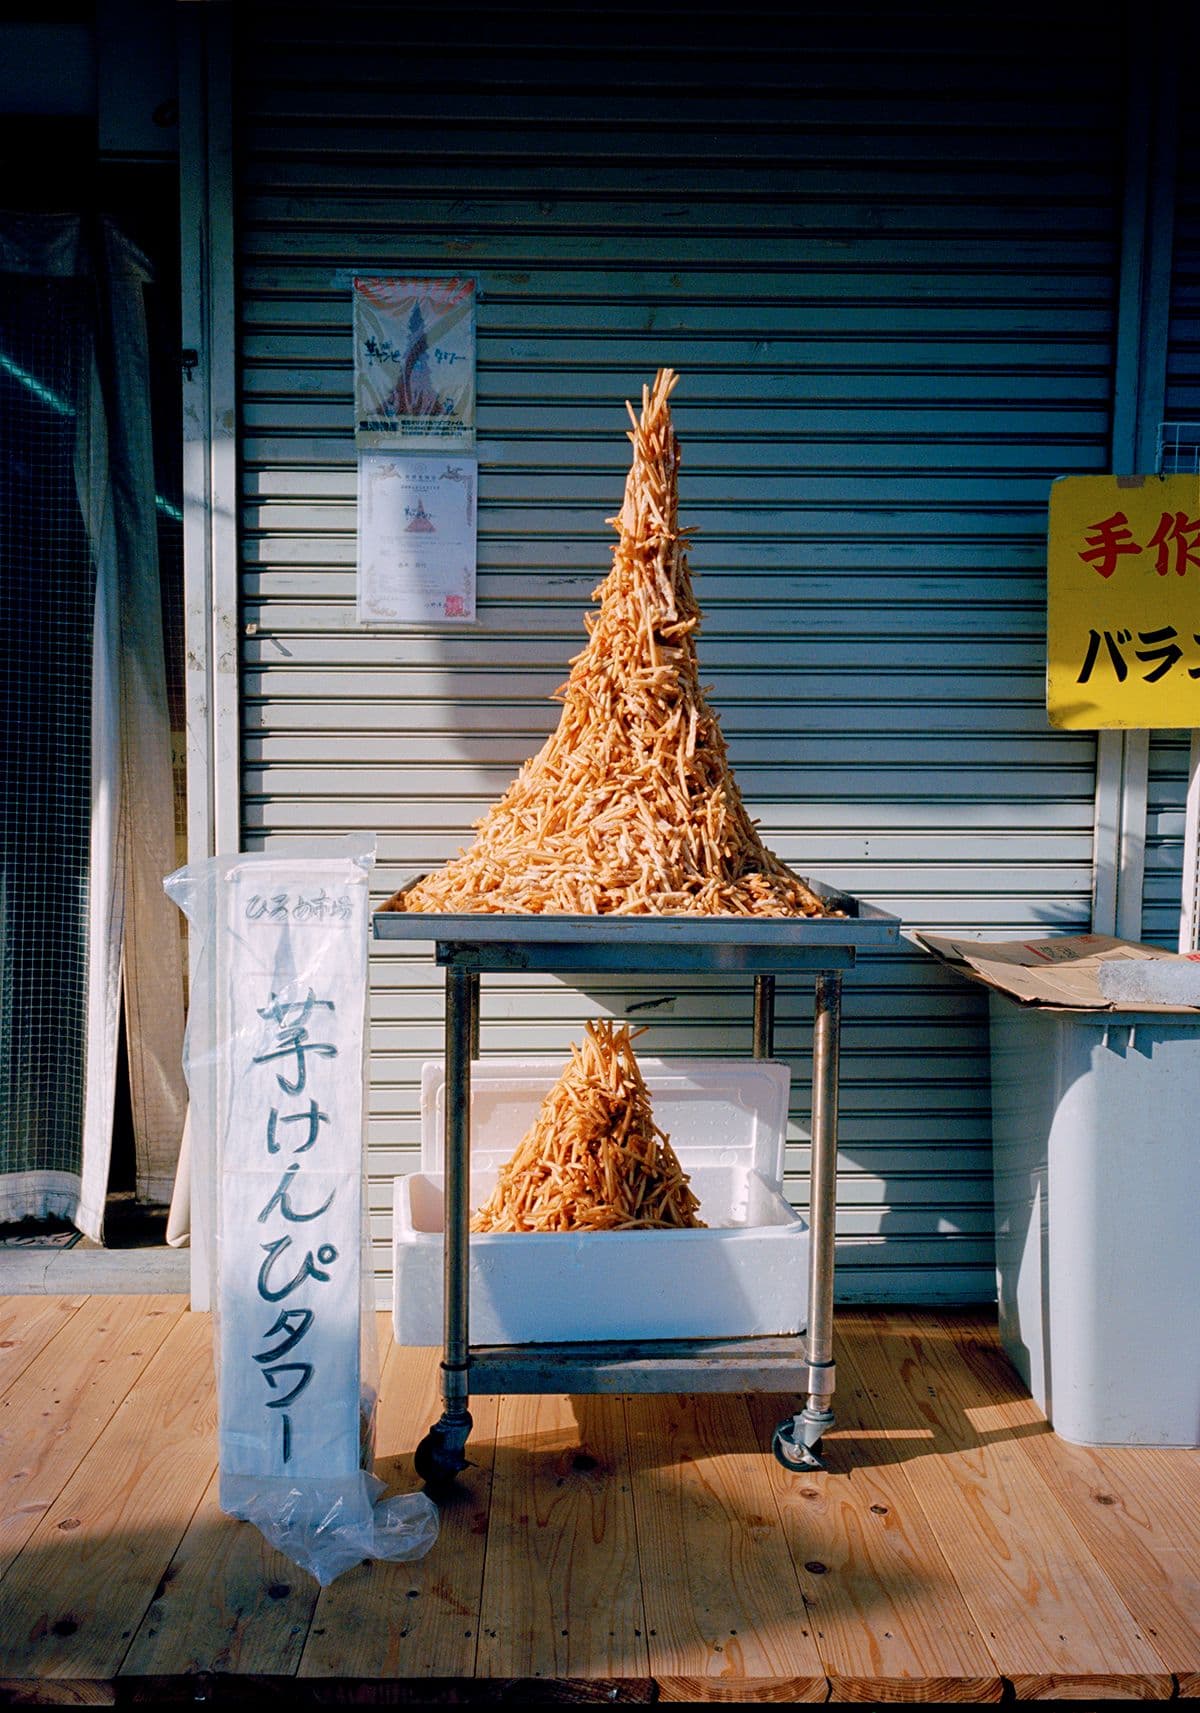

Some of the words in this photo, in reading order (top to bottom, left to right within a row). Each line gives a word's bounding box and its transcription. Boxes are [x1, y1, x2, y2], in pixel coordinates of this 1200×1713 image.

[1076, 626, 1200, 683] バラ
[245, 888, 354, 921] ひろめ市場
[252, 987, 339, 1464] 芋けんぴタワー
